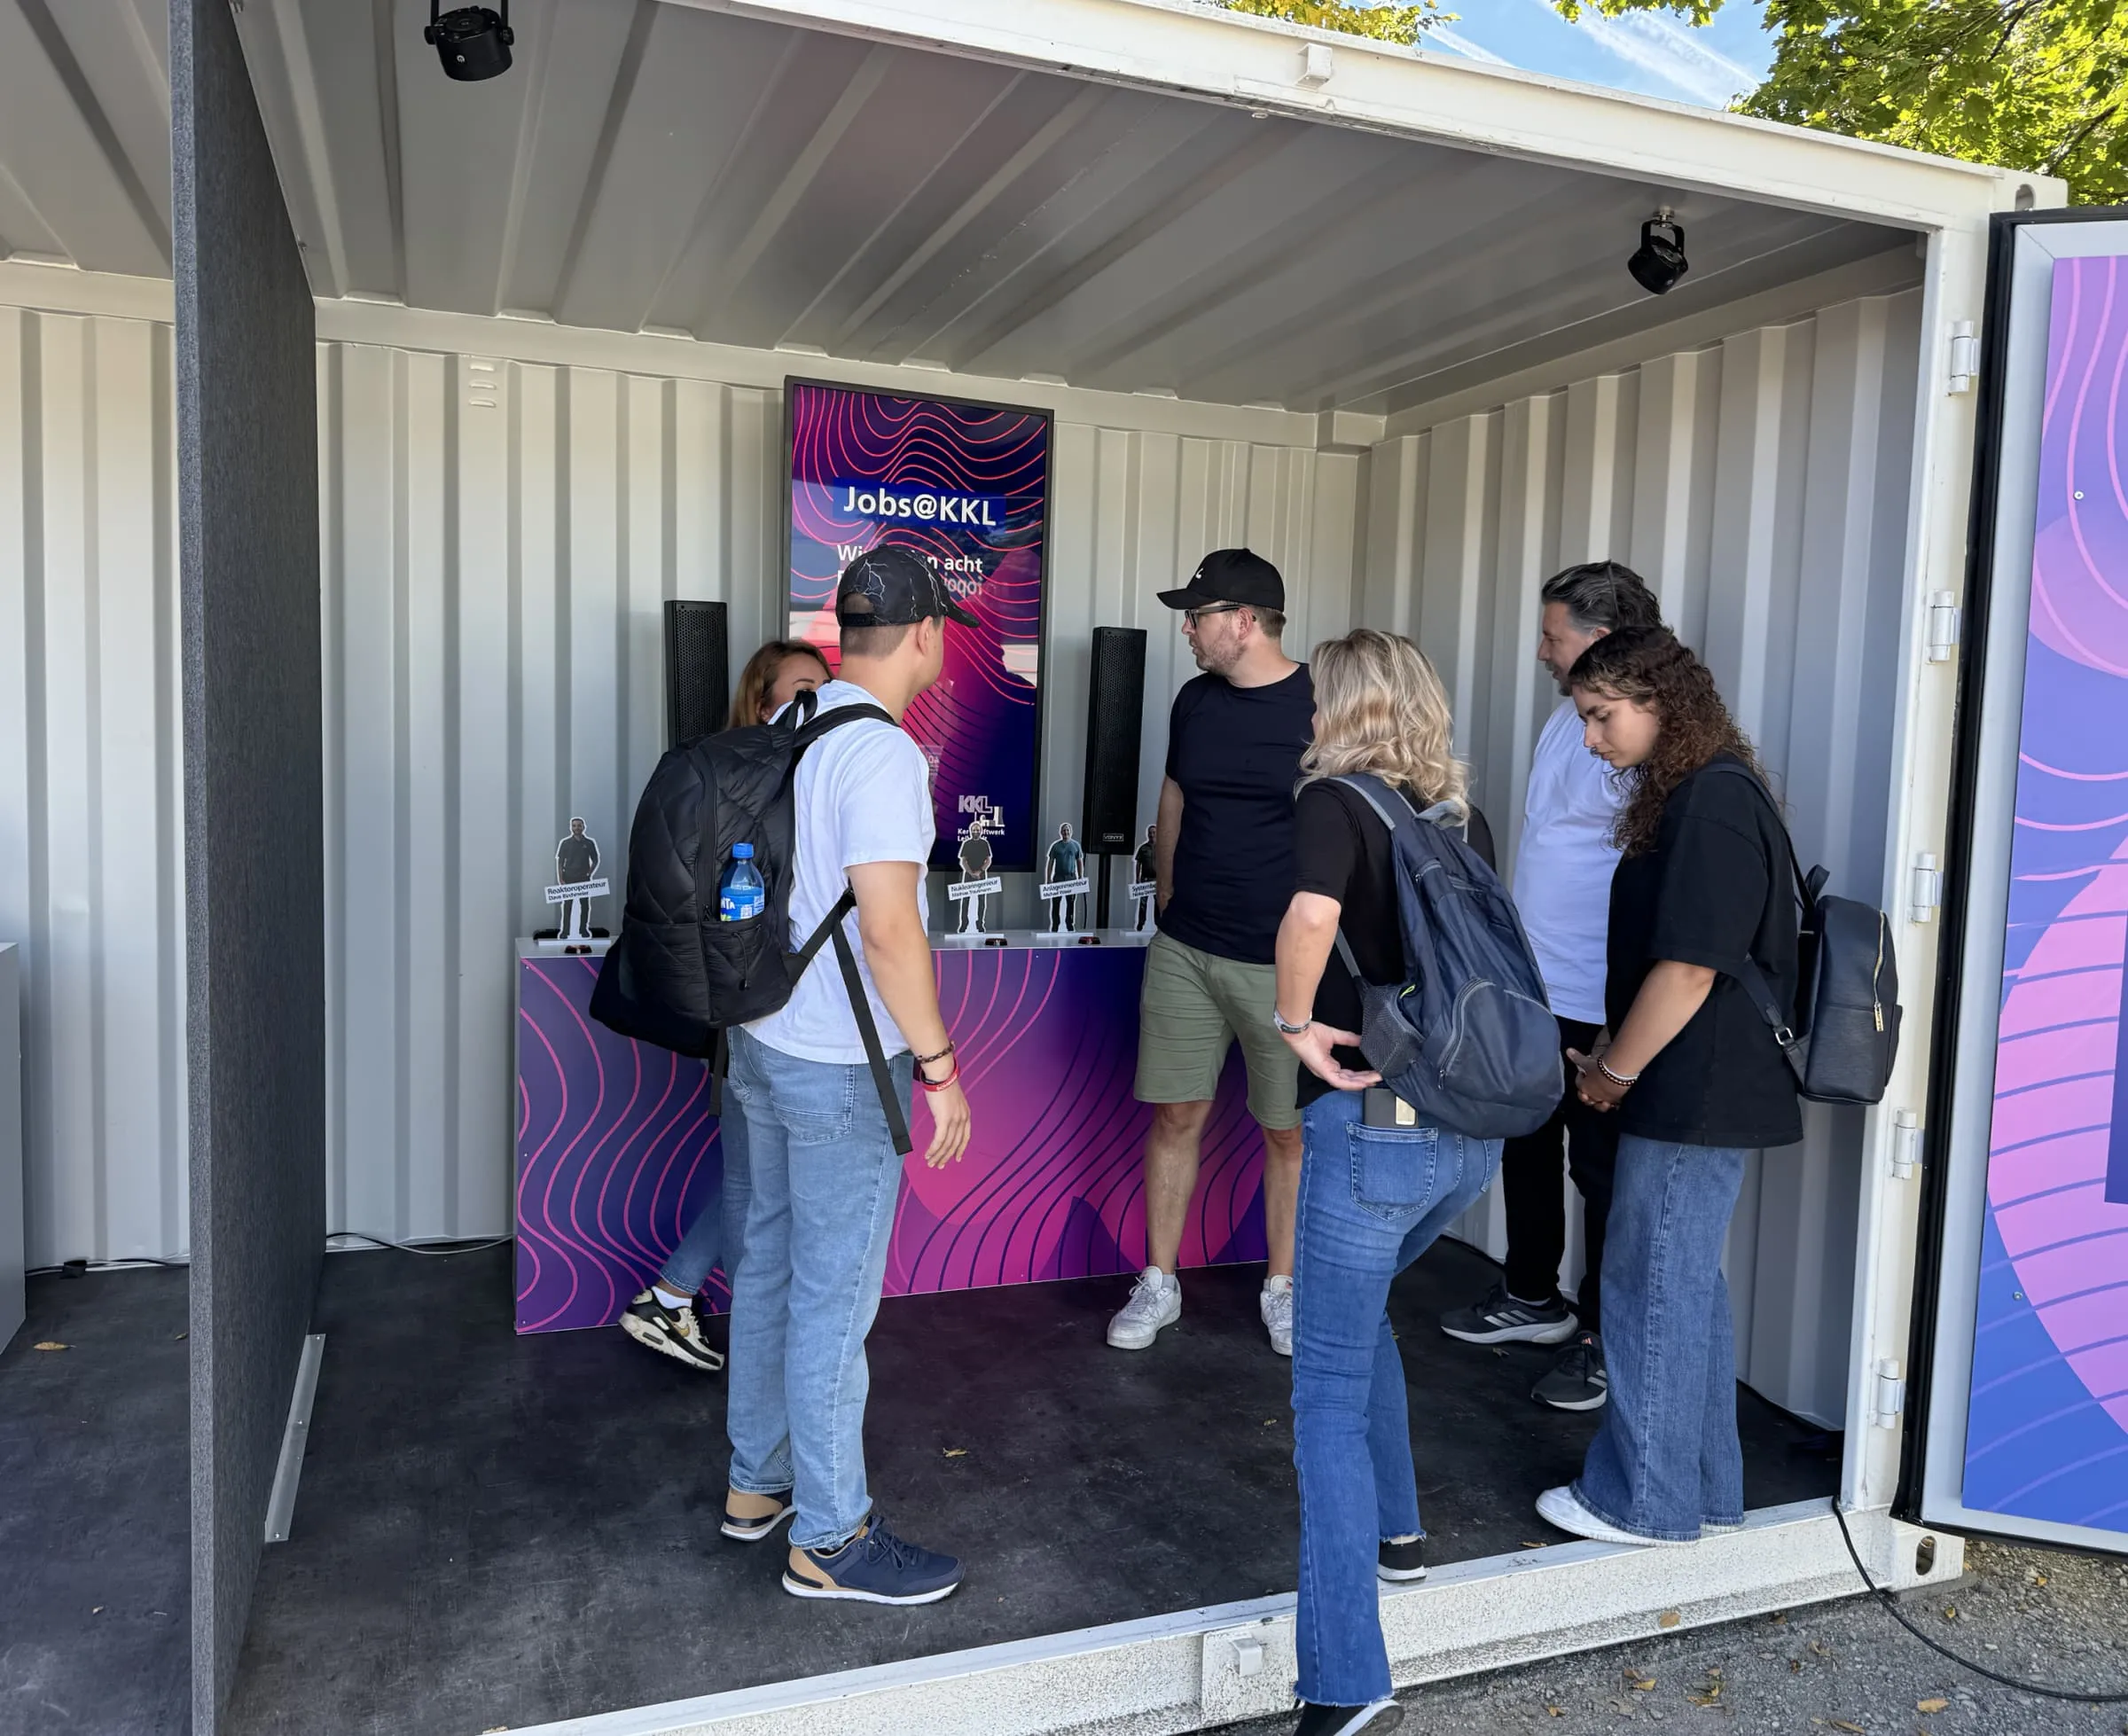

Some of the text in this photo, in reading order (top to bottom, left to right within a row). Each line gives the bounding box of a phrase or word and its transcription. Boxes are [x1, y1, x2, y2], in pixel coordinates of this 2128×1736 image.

[844, 487, 996, 526] Jobs@KKL
[943, 555, 983, 574] acht
[958, 794, 993, 814] KKL
[547, 881, 606, 895] Reaktoroperateur
